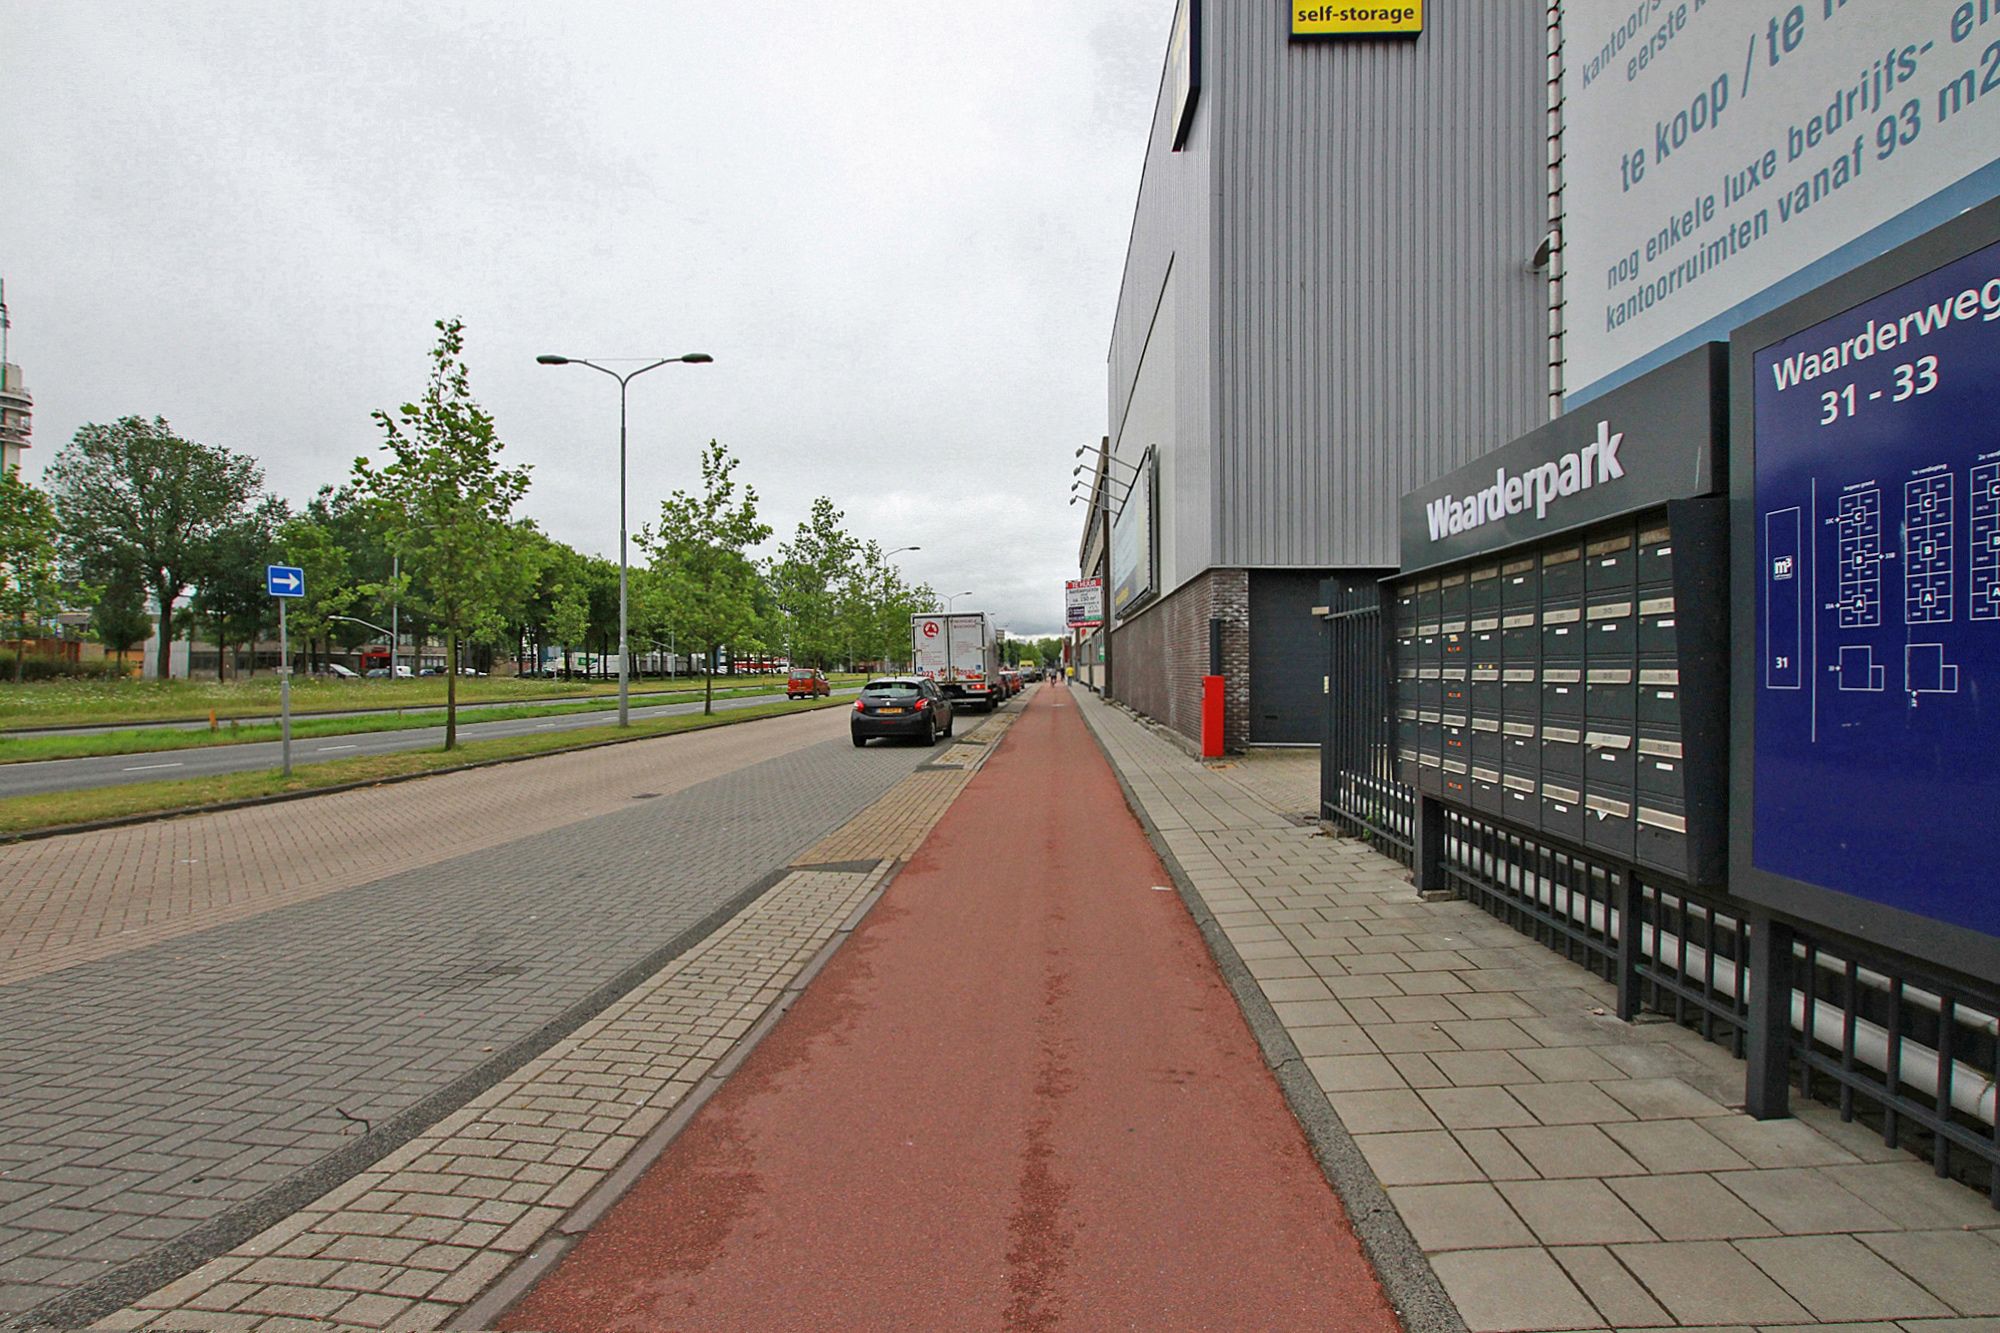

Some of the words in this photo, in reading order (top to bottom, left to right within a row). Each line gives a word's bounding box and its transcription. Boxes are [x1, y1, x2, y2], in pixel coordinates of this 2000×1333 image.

[1298, 6, 1414, 24] self-storage
[1627, 4, 1686, 82] eerste
[1620, 148, 1645, 193] te
[1655, 72, 1728, 165] koop
[1766, 1, 1804, 67] te
[1606, 208, 1768, 332] kantoorruimten
[1778, 134, 1863, 224] vanaf
[1877, 98, 1921, 161] 93
[1607, 249, 1639, 290] nog
[1646, 194, 1715, 262] enkele
[1724, 149, 1776, 208] luxe
[1788, 40, 1933, 163] bedrijfs-
[1772, 278, 2000, 391] Waarderweg
[1820, 383, 1856, 426] 31
[1893, 355, 1939, 402] 33
[1426, 420, 1625, 542] Waarderpark
[1775, 656, 1788, 669] 31
